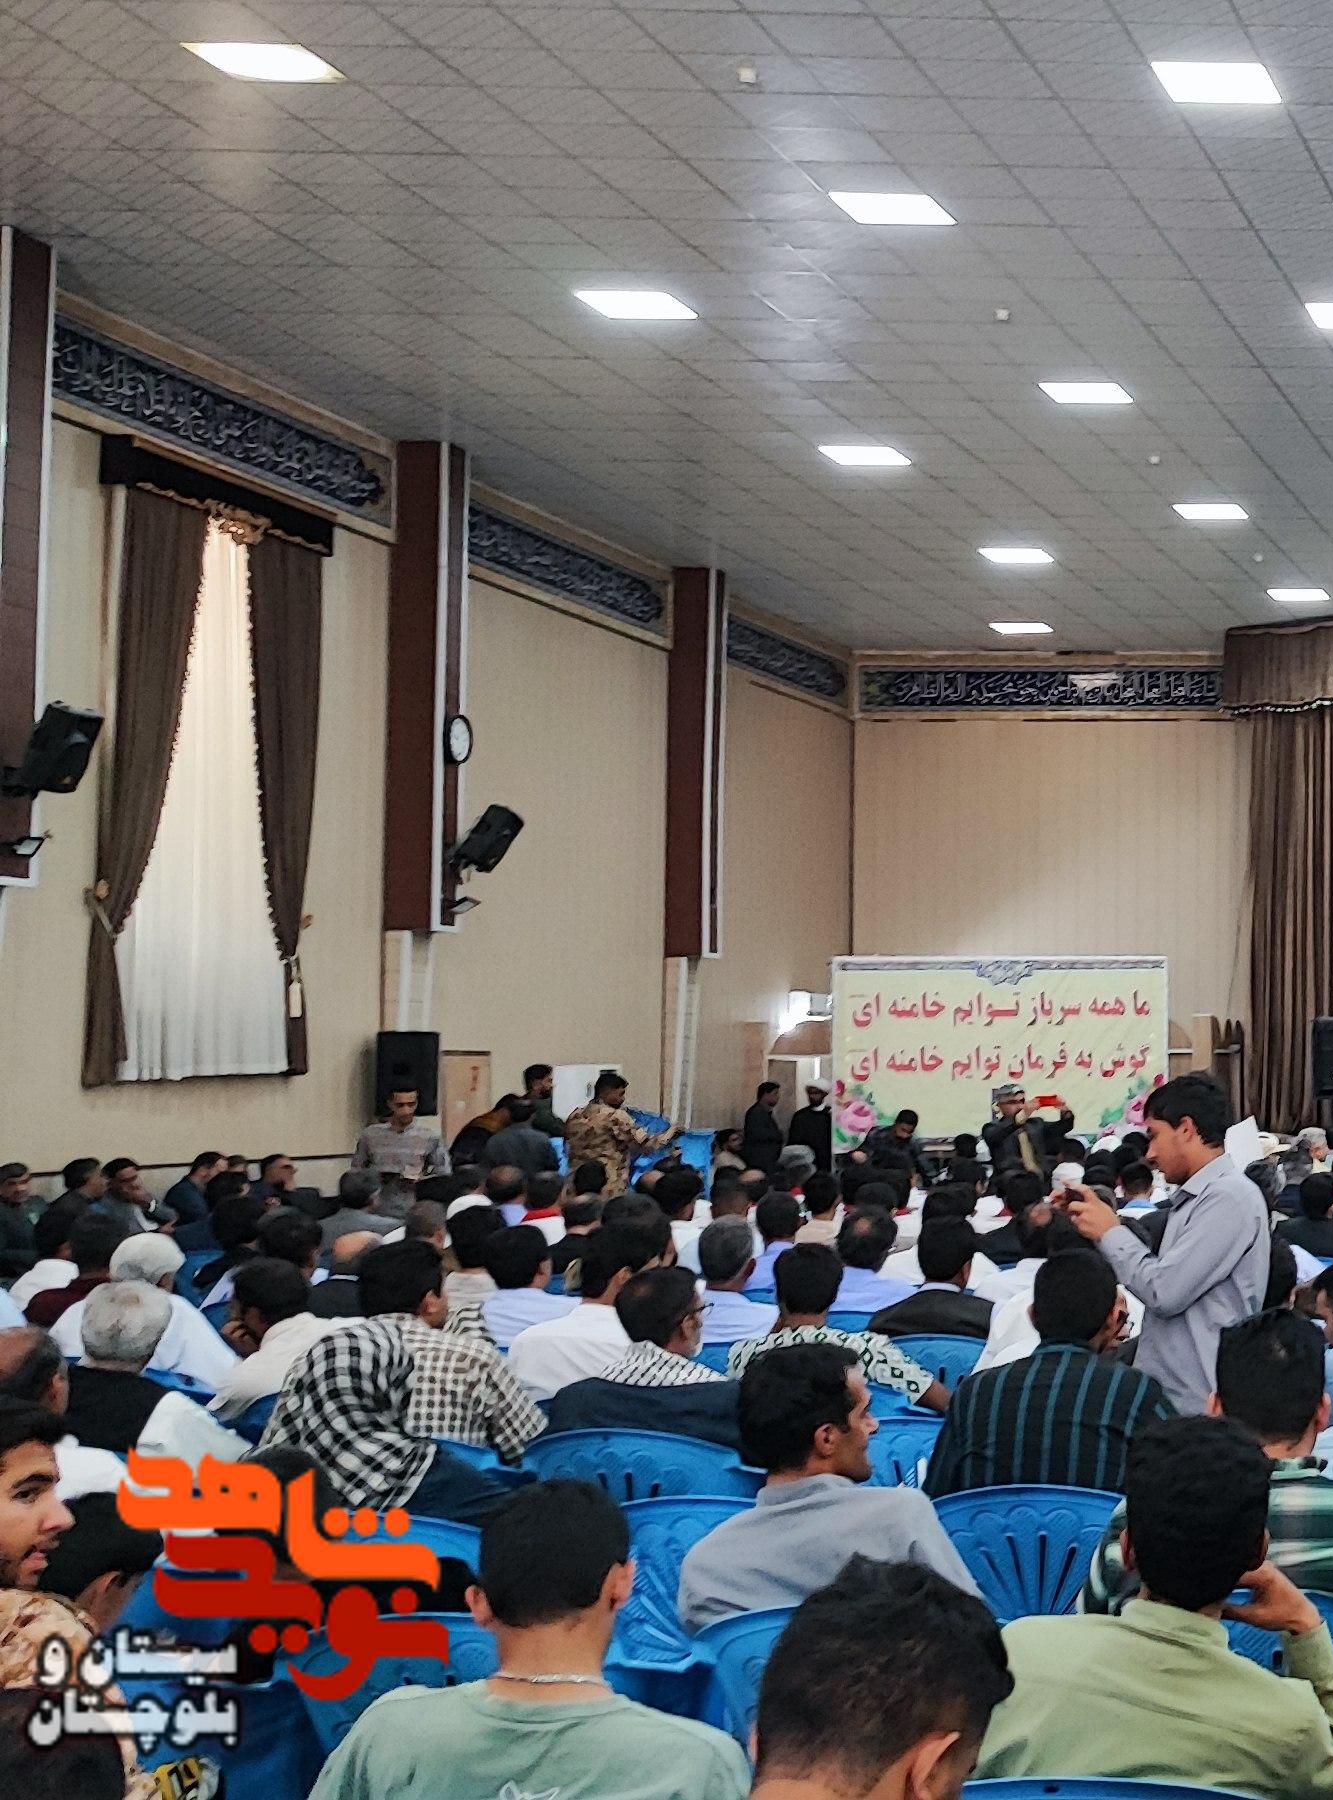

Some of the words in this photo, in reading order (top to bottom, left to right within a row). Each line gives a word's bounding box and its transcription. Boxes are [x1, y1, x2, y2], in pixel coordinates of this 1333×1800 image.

[853, 991, 880, 1028] ای
[887, 991, 945, 1018] خامنه
[1027, 991, 1082, 1027] سرباز
[1088, 997, 1125, 1017] همه
[1133, 990, 1151, 1017] ما
[851, 1047, 879, 1081] ای
[885, 1045, 944, 1072] خامنه
[1007, 1041, 1068, 1079] فرمان
[1074, 1051, 1092, 1077] به
[1100, 1044, 1150, 1078] گوش
